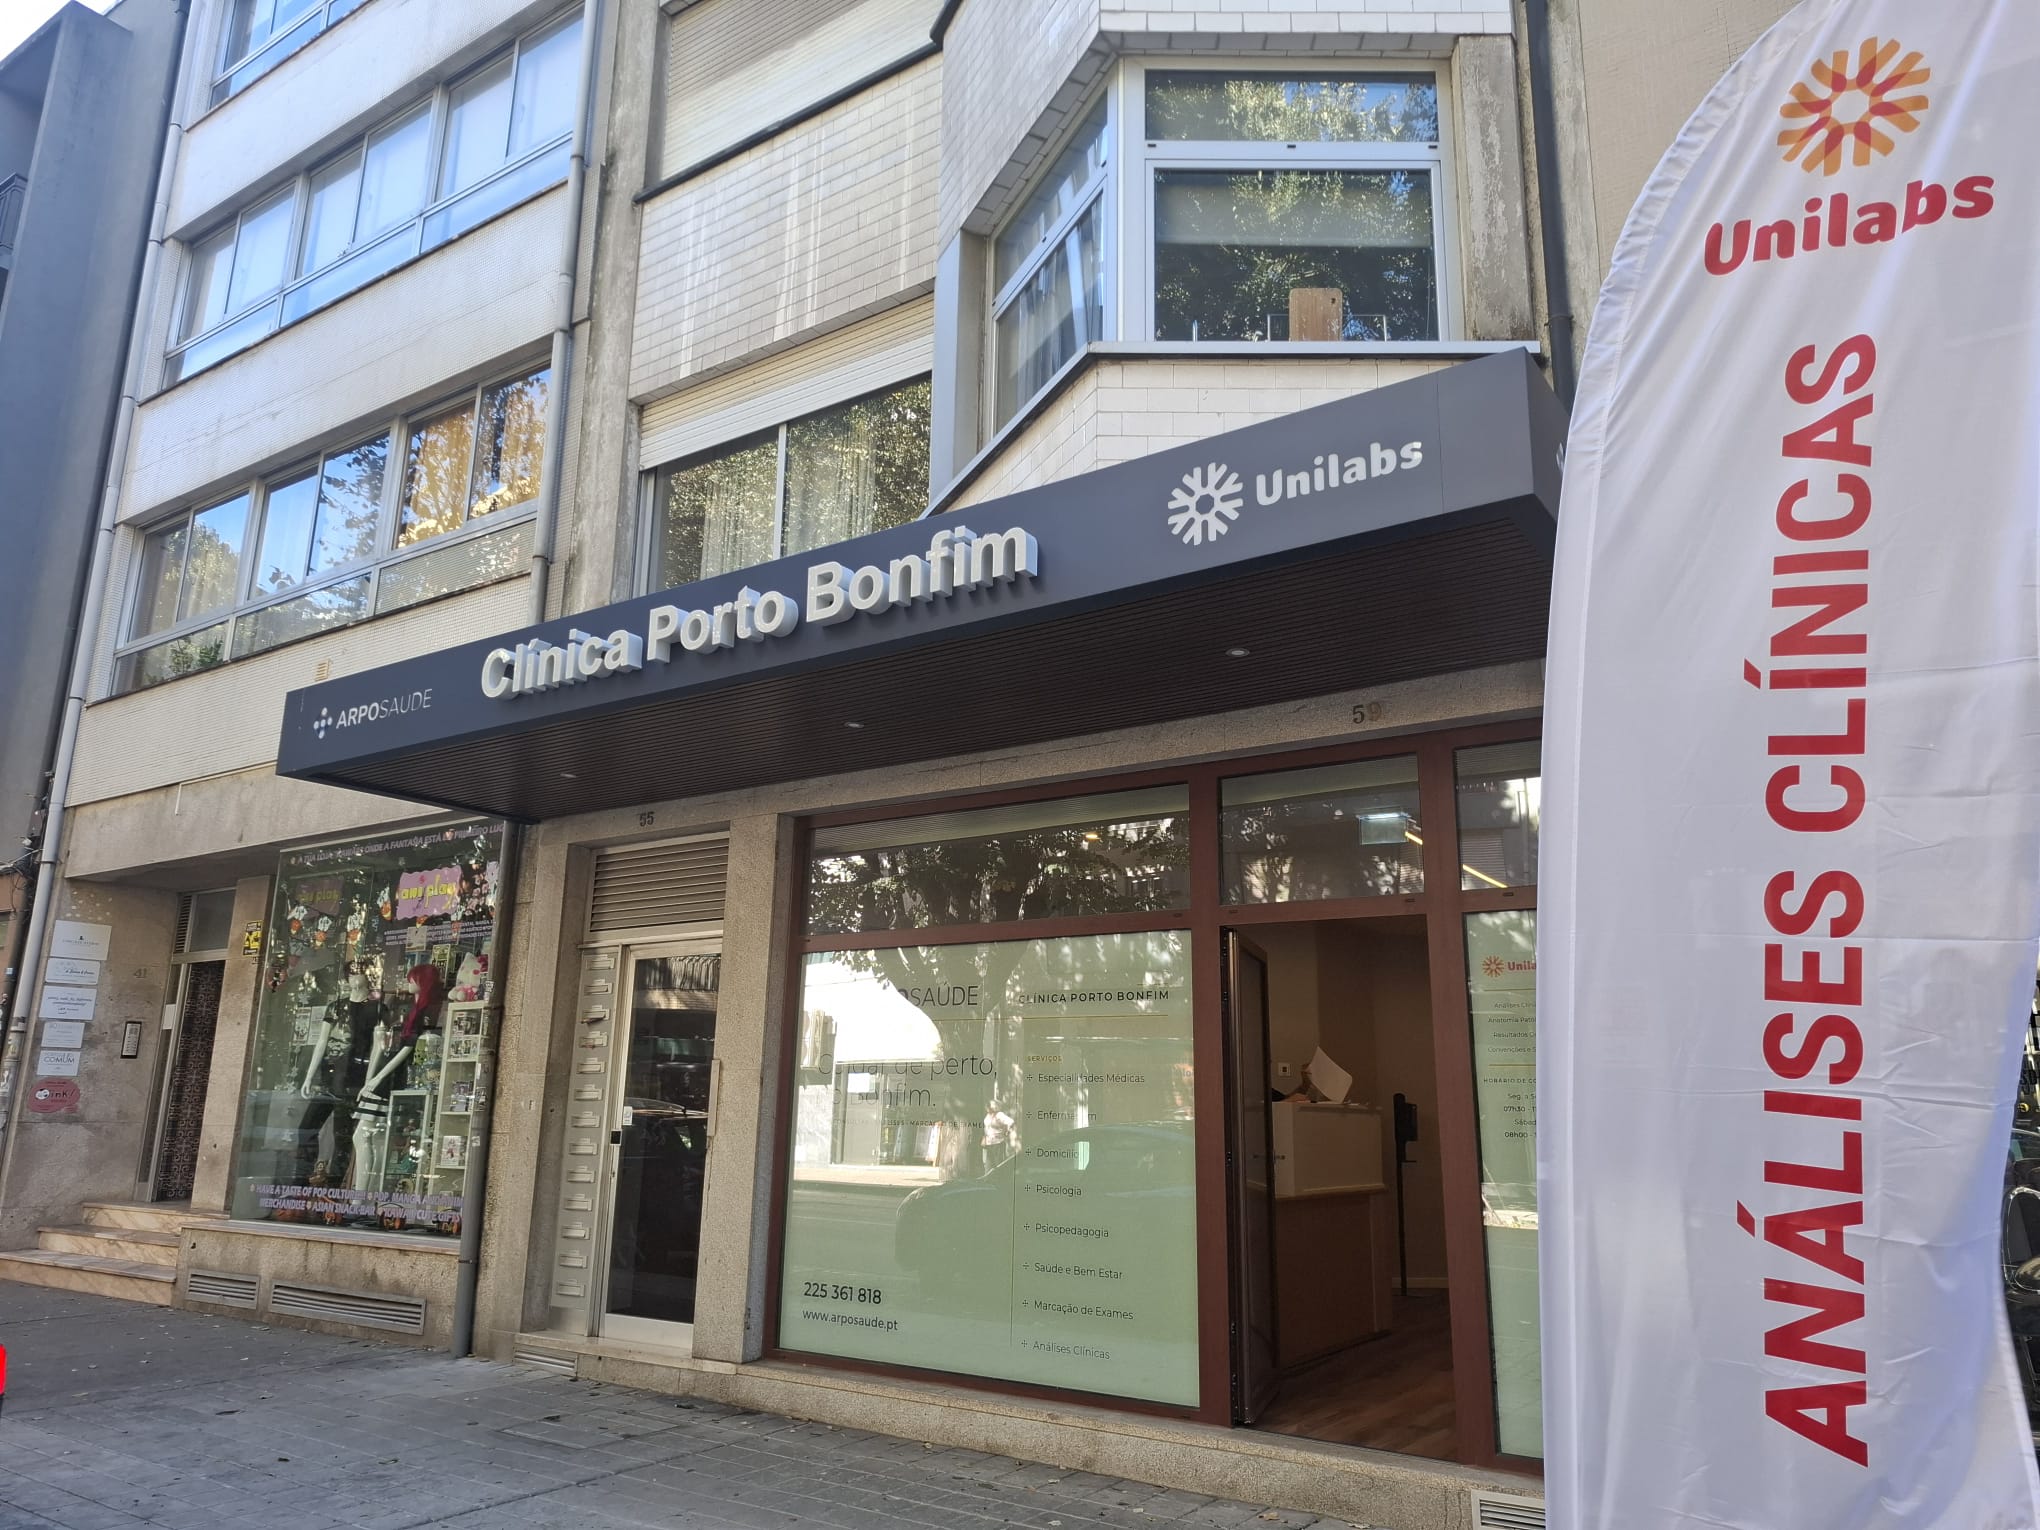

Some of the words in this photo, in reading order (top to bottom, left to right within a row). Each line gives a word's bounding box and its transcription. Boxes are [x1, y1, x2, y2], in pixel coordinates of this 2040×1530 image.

[1703, 175, 1995, 276] Unilabs
[1255, 441, 1424, 506] Unilabs
[1743, 333, 1878, 834] CLÍNICAS
[481, 628, 643, 700] Clínica
[646, 585, 800, 664] Porto
[806, 525, 1039, 627] Bonfim
[1352, 702, 1382, 724] 59
[639, 811, 655, 827] 55
[1018, 992, 1067, 1004] CLÍNICA
[1070, 991, 1113, 1003] PORTO
[1117, 990, 1170, 1001] BONFIM
[930, 1054, 998, 1081] perto,
[1106, 1073, 1145, 1083] Médicas
[1736, 869, 1869, 1469] ANÁLISES
[312, 1187, 327, 1198] POP
[1036, 1184, 1082, 1198] Psicologia
[1035, 1222, 1109, 1239] Psicopedagogia
[1034, 1262, 1064, 1274] Saúde
[1073, 1265, 1096, 1277] Bem
[1098, 1267, 1123, 1280] Estar
[803, 1281, 828, 1299] 225
[831, 1284, 853, 1302] 361
[857, 1287, 882, 1305] 818
[1034, 1299, 1079, 1315] Marcação
[1080, 1305, 1094, 1316] de
[1095, 1306, 1134, 1320] Exames
[802, 1309, 899, 1333] www.arposaude.pt
[1032, 1340, 1071, 1354] Análises
[1073, 1345, 1110, 1360] Clínicas
